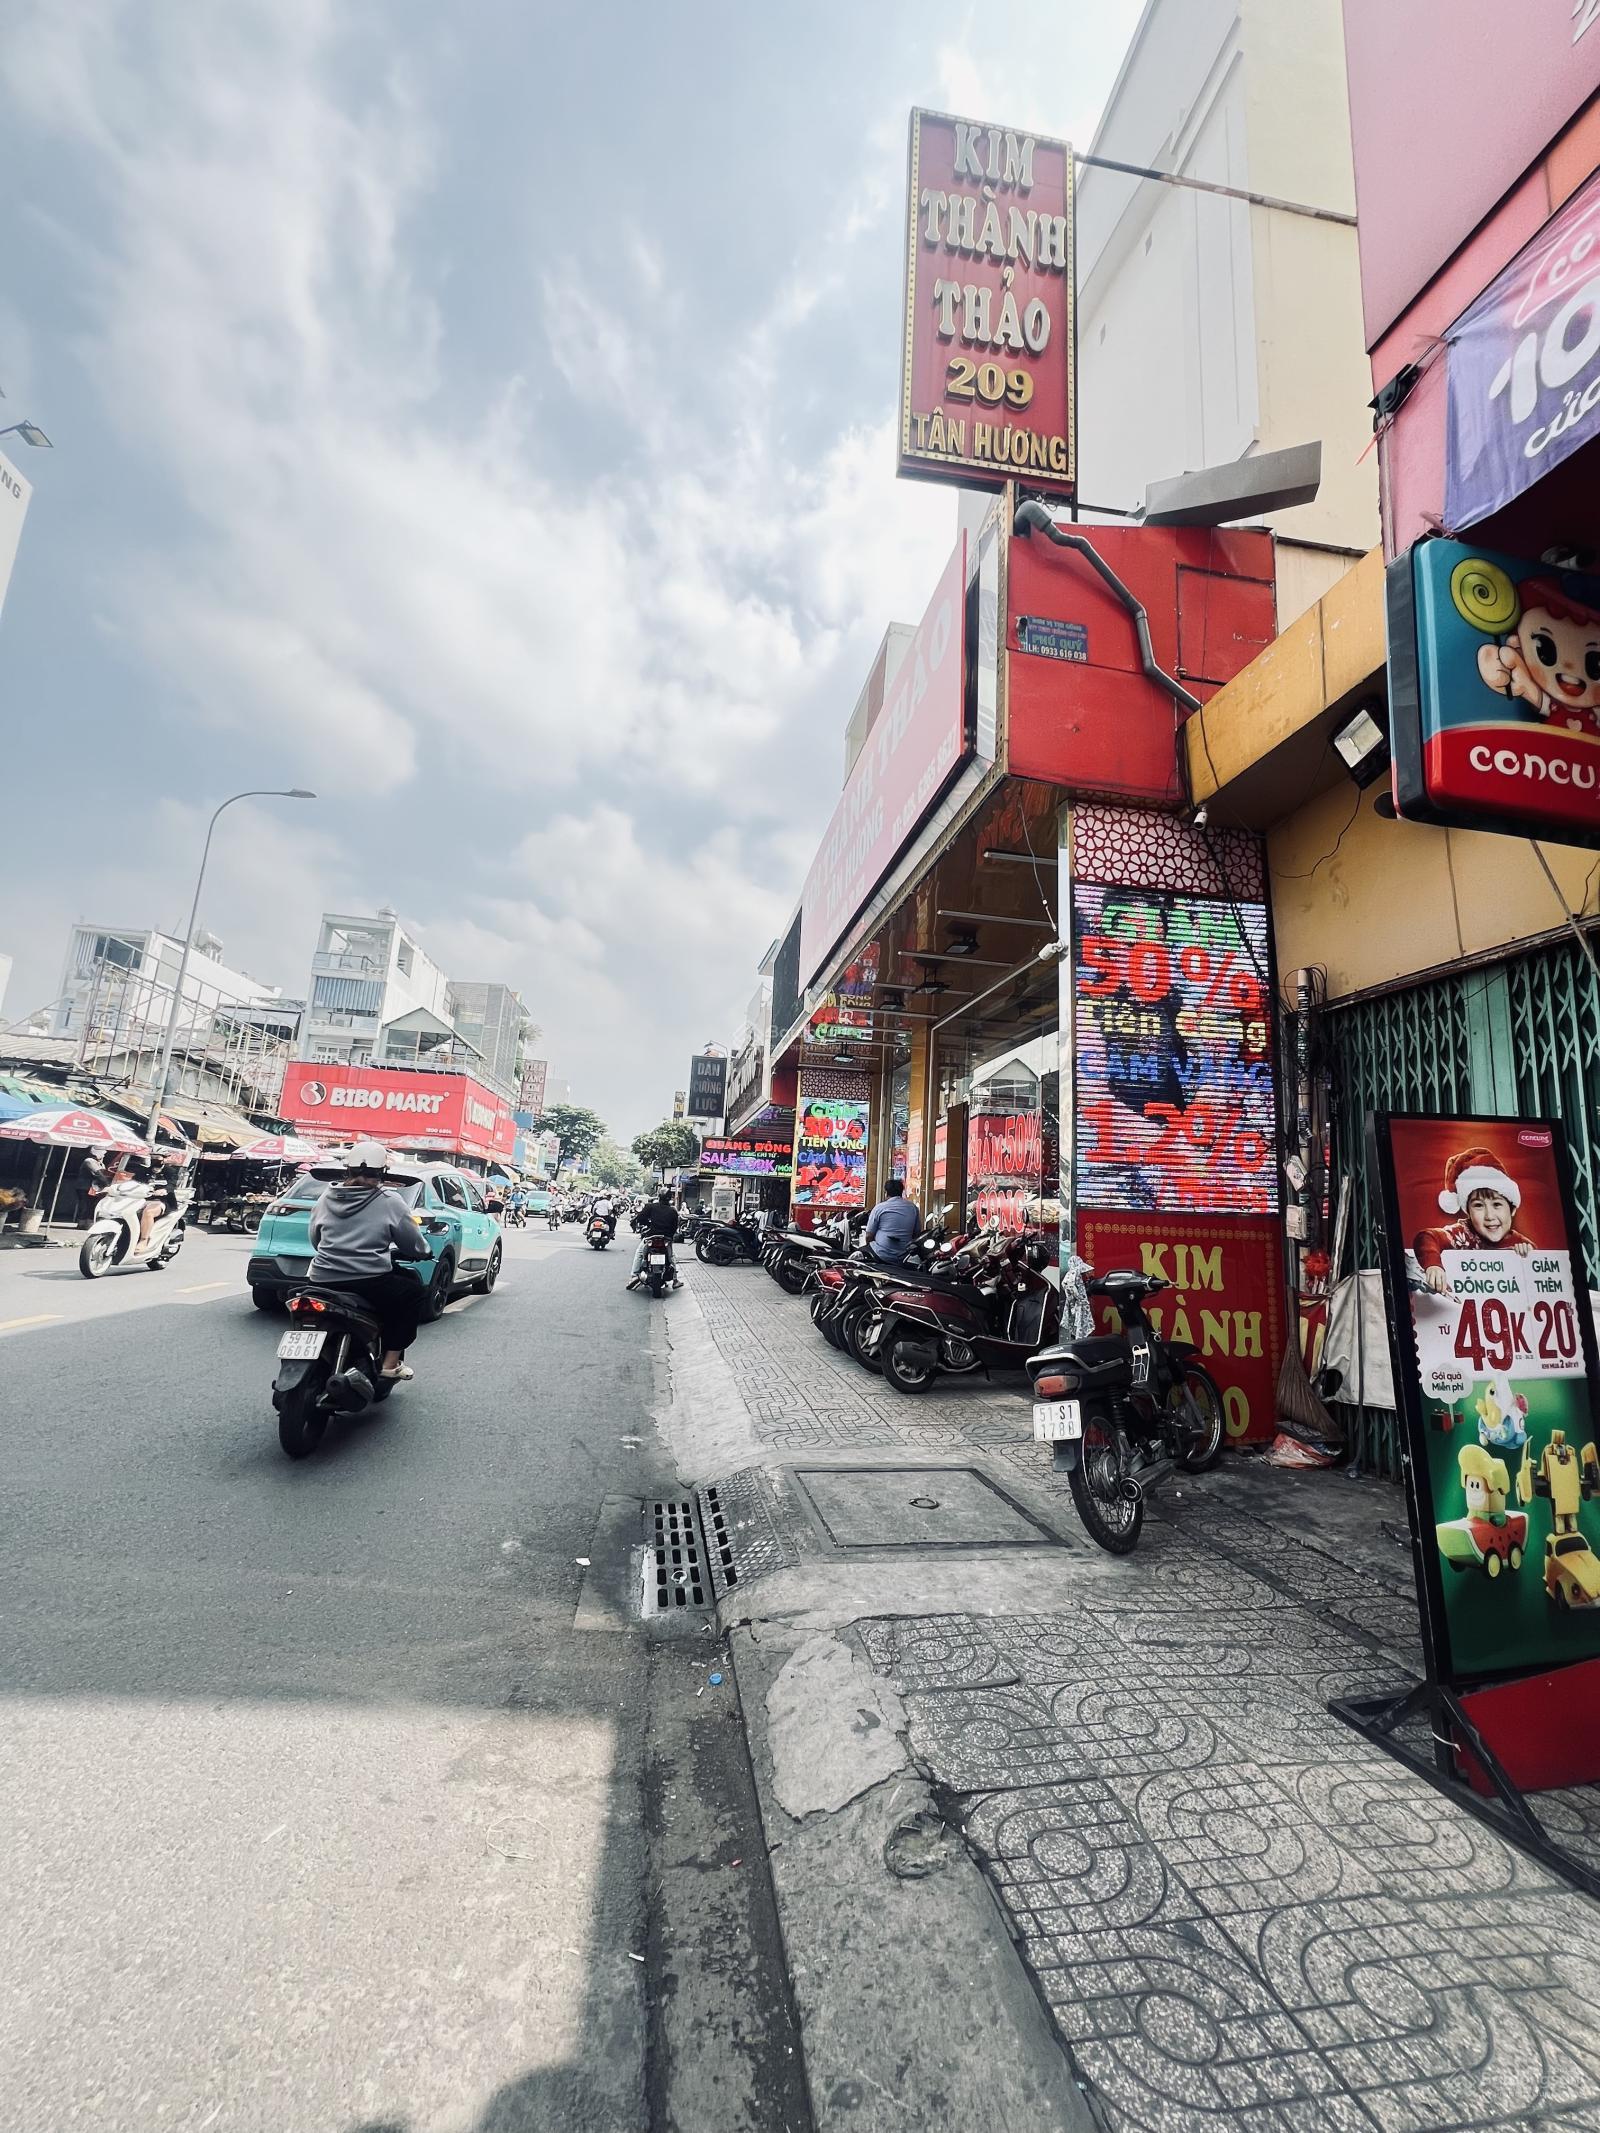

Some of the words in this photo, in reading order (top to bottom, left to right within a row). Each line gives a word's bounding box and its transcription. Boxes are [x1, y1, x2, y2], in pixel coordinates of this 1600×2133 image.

[954, 122, 1036, 188] KIM
[920, 185, 1067, 269] THÀNH
[934, 265, 1052, 353] THẢO
[946, 355, 1036, 407] 209
[910, 404, 965, 456] TÂN
[974, 420, 1068, 472] HƯƠNG
[1041, 645, 1058, 657] 0933
[1078, 934, 1264, 1009] 50%
[330, 1087, 384, 1109] BIBO
[386, 1091, 444, 1114] MART
[804, 1116, 866, 1139] 50%
[1004, 1106, 1042, 1174] 50%
[1139, 1242, 1225, 1292] KIM
[1461, 1257, 1477, 1272] ĐỒ
[1480, 1261, 1504, 1272] CHƠI
[1532, 1257, 1560, 1273] GIẢM
[1454, 1275, 1495, 1293] ĐỒNG
[1497, 1276, 1520, 1293] GIÁ
[1535, 1276, 1563, 1292] THÊM
[1559, 1360, 1564, 1368] 2
